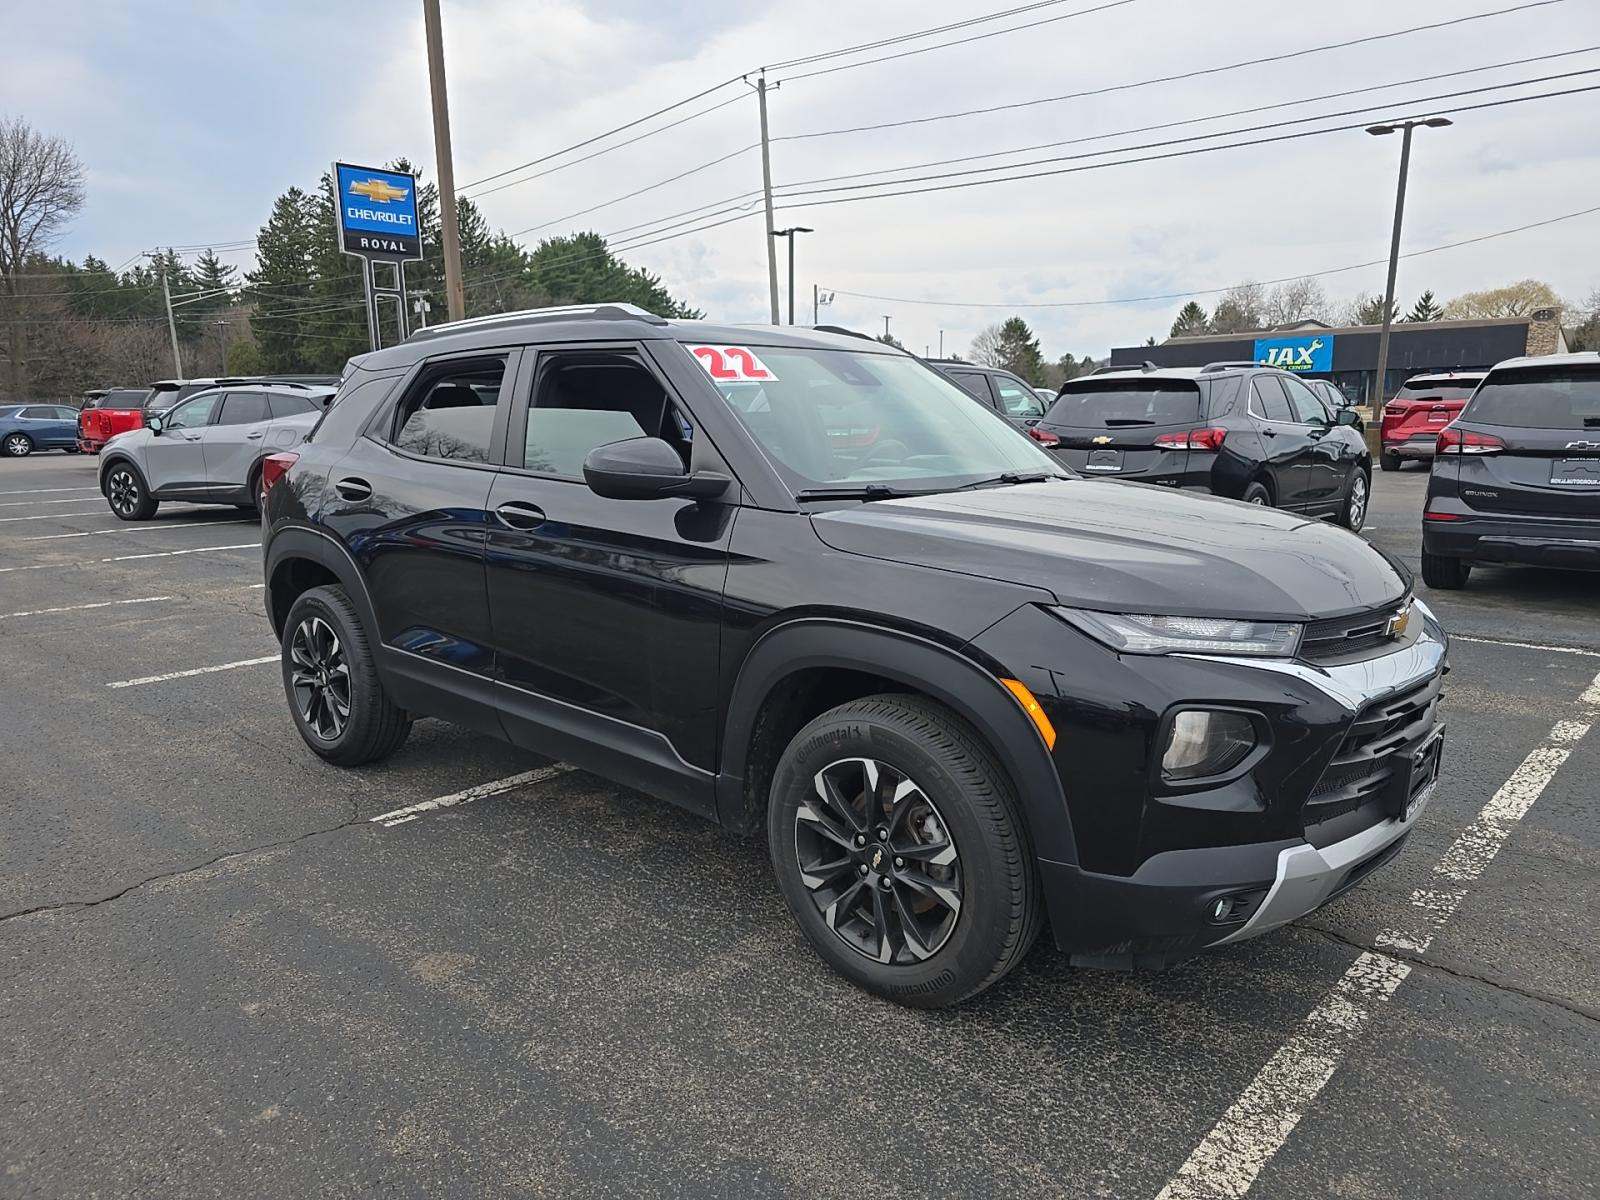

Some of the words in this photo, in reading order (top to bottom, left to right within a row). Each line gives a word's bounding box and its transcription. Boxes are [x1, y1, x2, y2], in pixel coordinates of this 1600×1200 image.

[347, 207, 413, 224] CHEVROLET
[360, 238, 407, 252] ROYAL
[692, 346, 769, 379] 22
[1260, 343, 1317, 365] JAX
